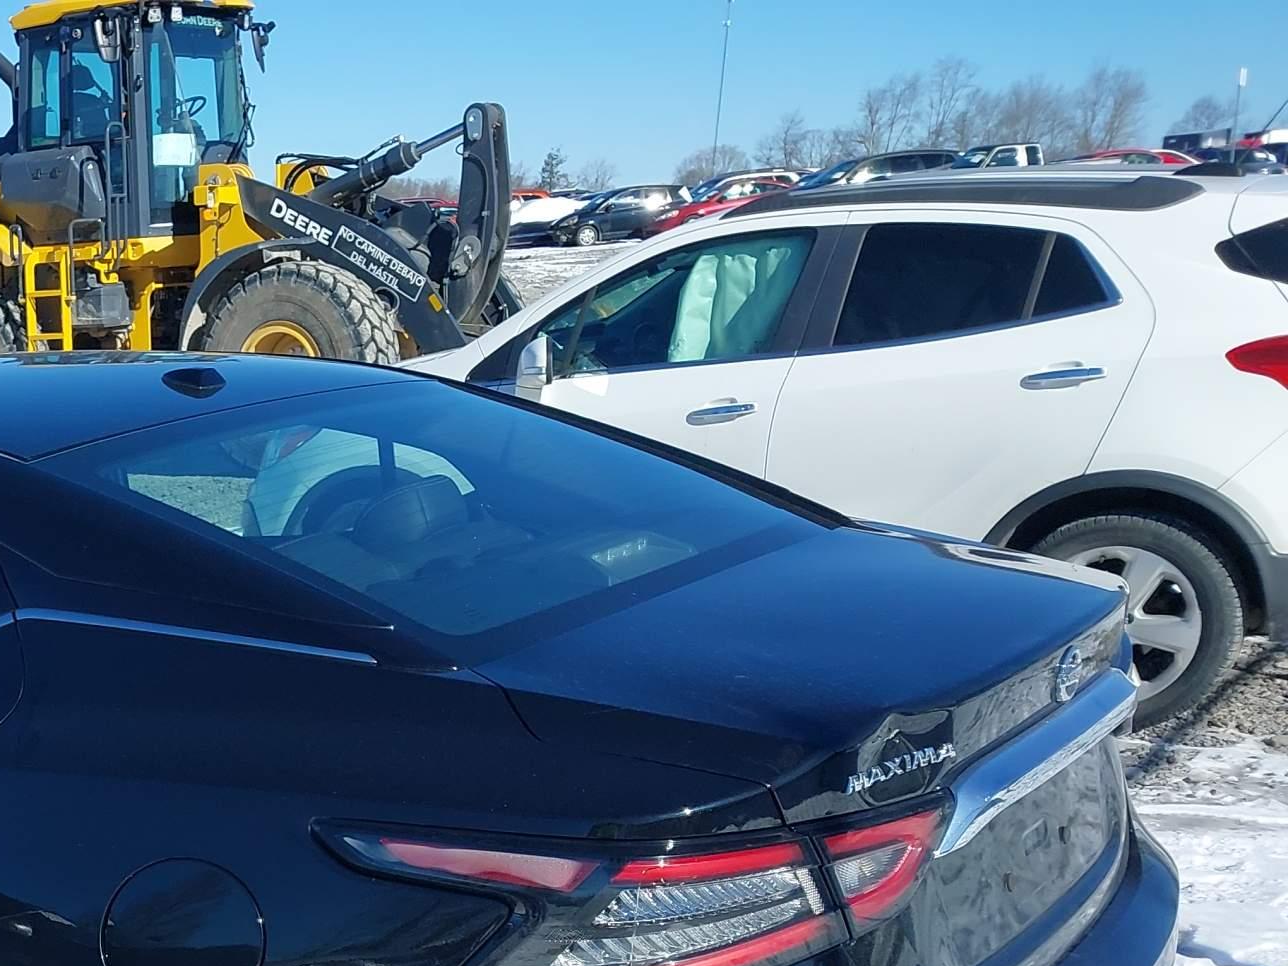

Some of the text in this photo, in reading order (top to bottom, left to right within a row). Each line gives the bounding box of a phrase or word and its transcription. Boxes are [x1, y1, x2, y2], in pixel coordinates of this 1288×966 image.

[269, 198, 333, 246] DEERE
[340, 228, 425, 287] NO CAMINE DEBAJO
[349, 251, 400, 290] DEL MÁSTIL
[845, 743, 956, 795] MAXIMA
